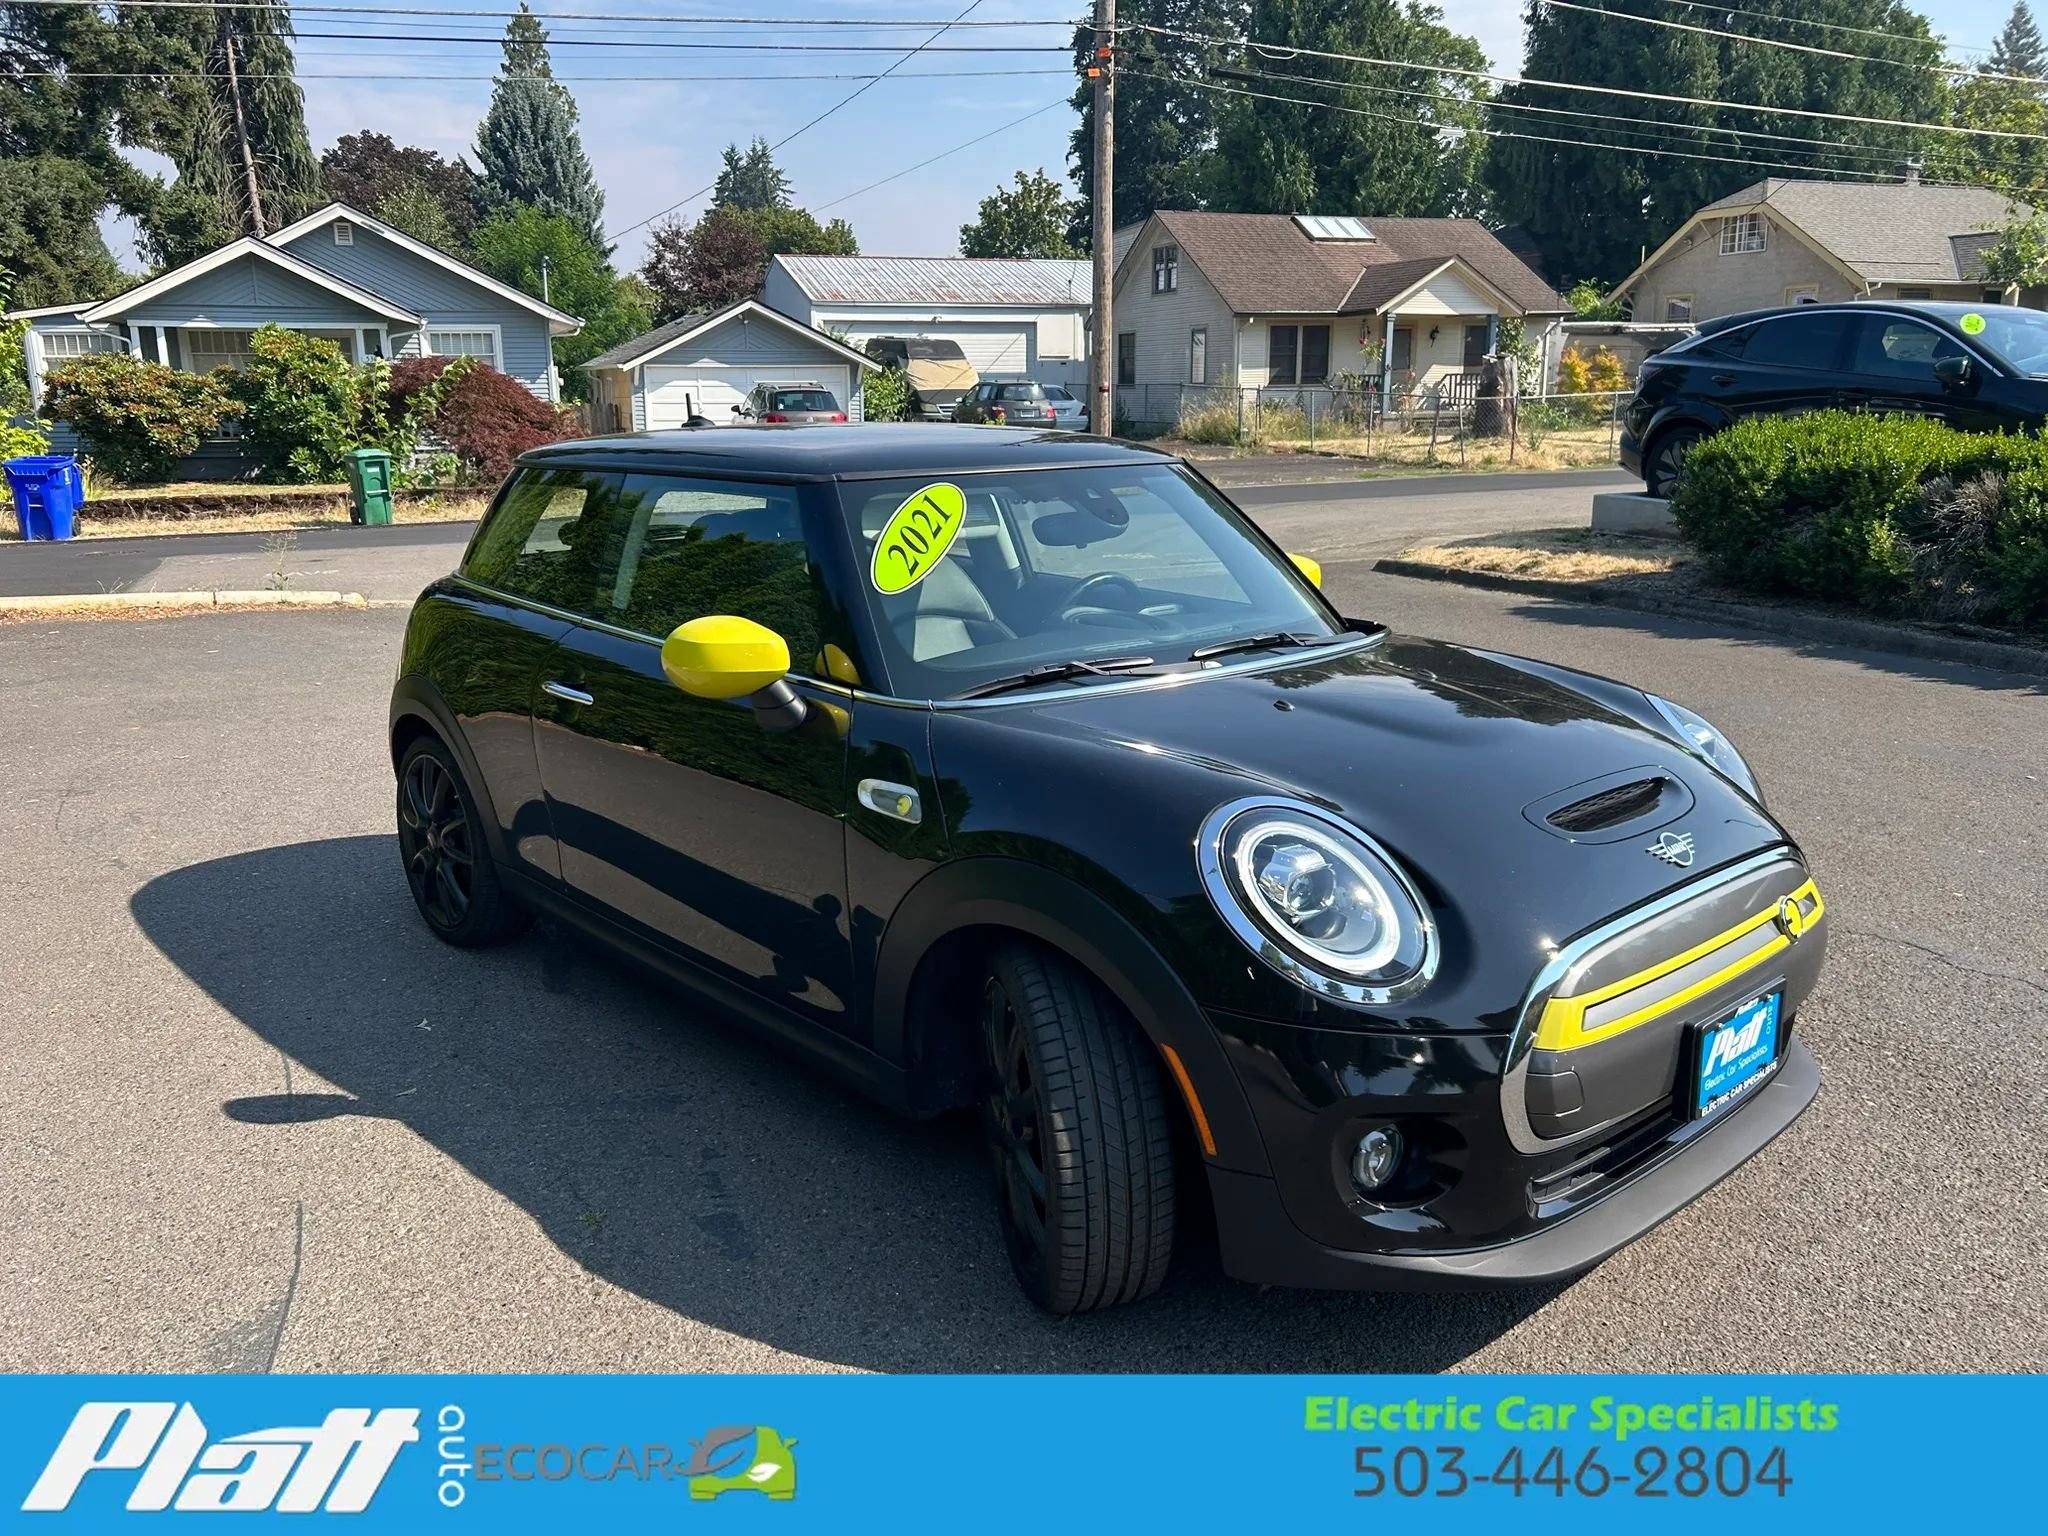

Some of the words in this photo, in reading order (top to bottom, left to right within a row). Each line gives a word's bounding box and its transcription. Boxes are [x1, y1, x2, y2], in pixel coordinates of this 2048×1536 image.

[888, 494, 952, 577] 2021
[1703, 1007, 1767, 1077] Platt
[1765, 1005, 1774, 1035] auto
[1701, 1092, 1731, 1118] ELECTRIC
[1730, 1084, 1743, 1099] CAR
[1743, 1061, 1778, 1091] SPECIALISTS
[1705, 1072, 1726, 1091] Electric
[1726, 1064, 1737, 1077] Car
[1738, 1044, 1769, 1070] Specialists
